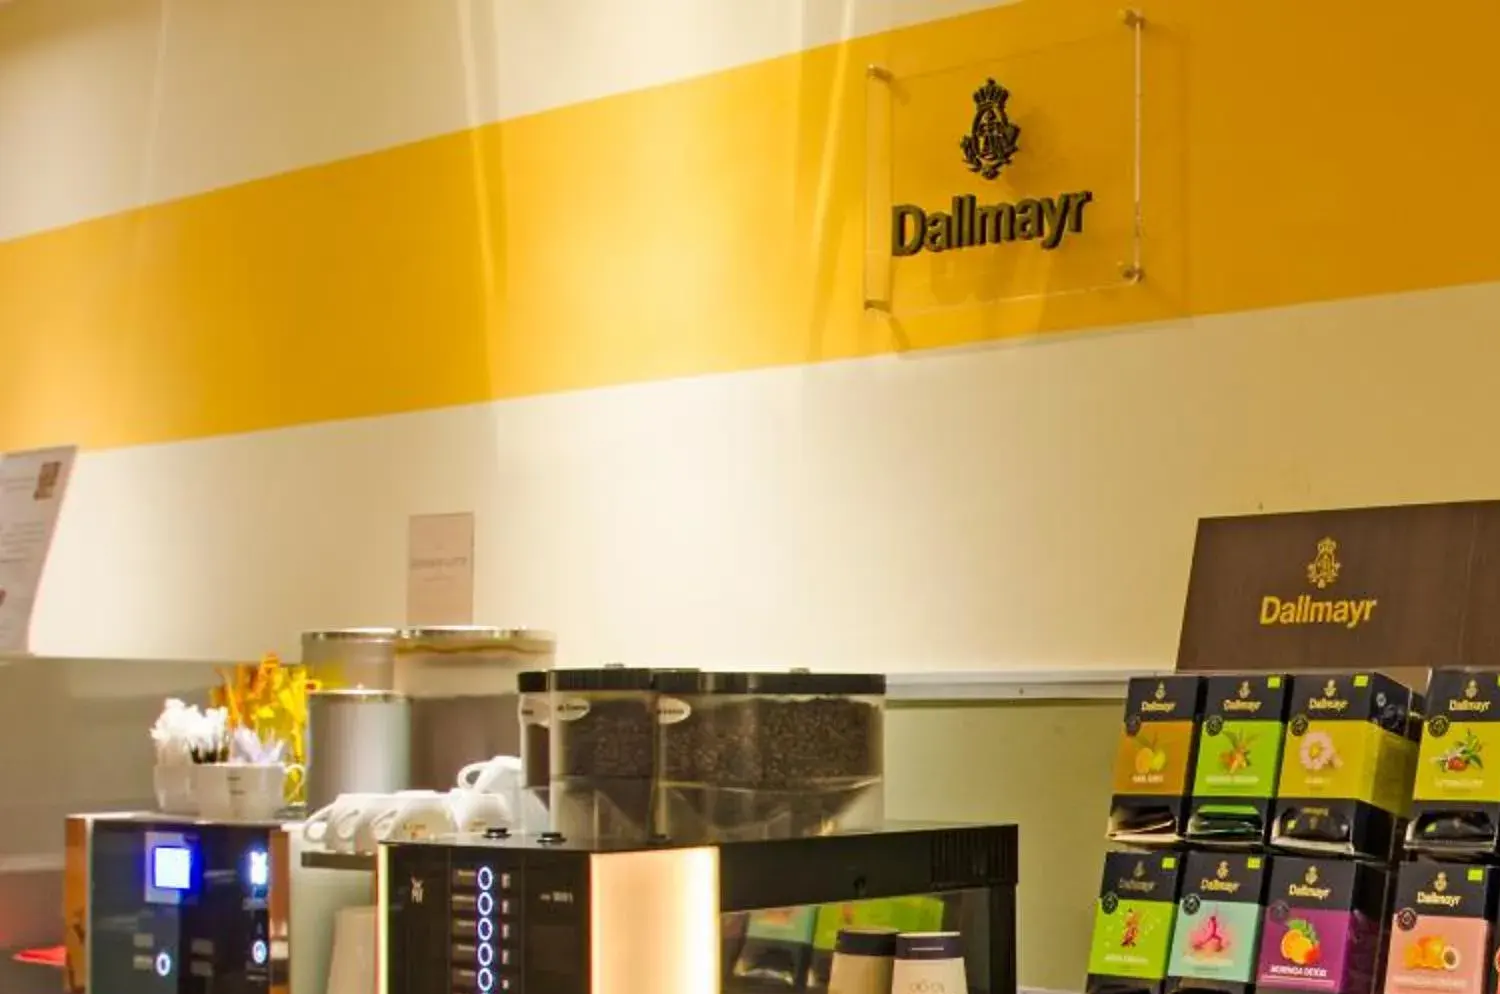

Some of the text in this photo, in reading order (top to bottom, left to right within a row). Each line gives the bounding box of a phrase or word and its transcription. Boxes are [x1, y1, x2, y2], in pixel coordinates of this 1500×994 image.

[892, 191, 1092, 257] Dallmayr
[1260, 595, 1377, 628] Dallmayr
[1223, 699, 1262, 712] Dallmayr
[1308, 697, 1349, 711] Dallmayr
[1449, 698, 1492, 713] Dallmayr
[1200, 877, 1240, 894] Dallmayr
[1288, 882, 1332, 899] Dallmayr
[1417, 890, 1461, 907] Dallmayr
